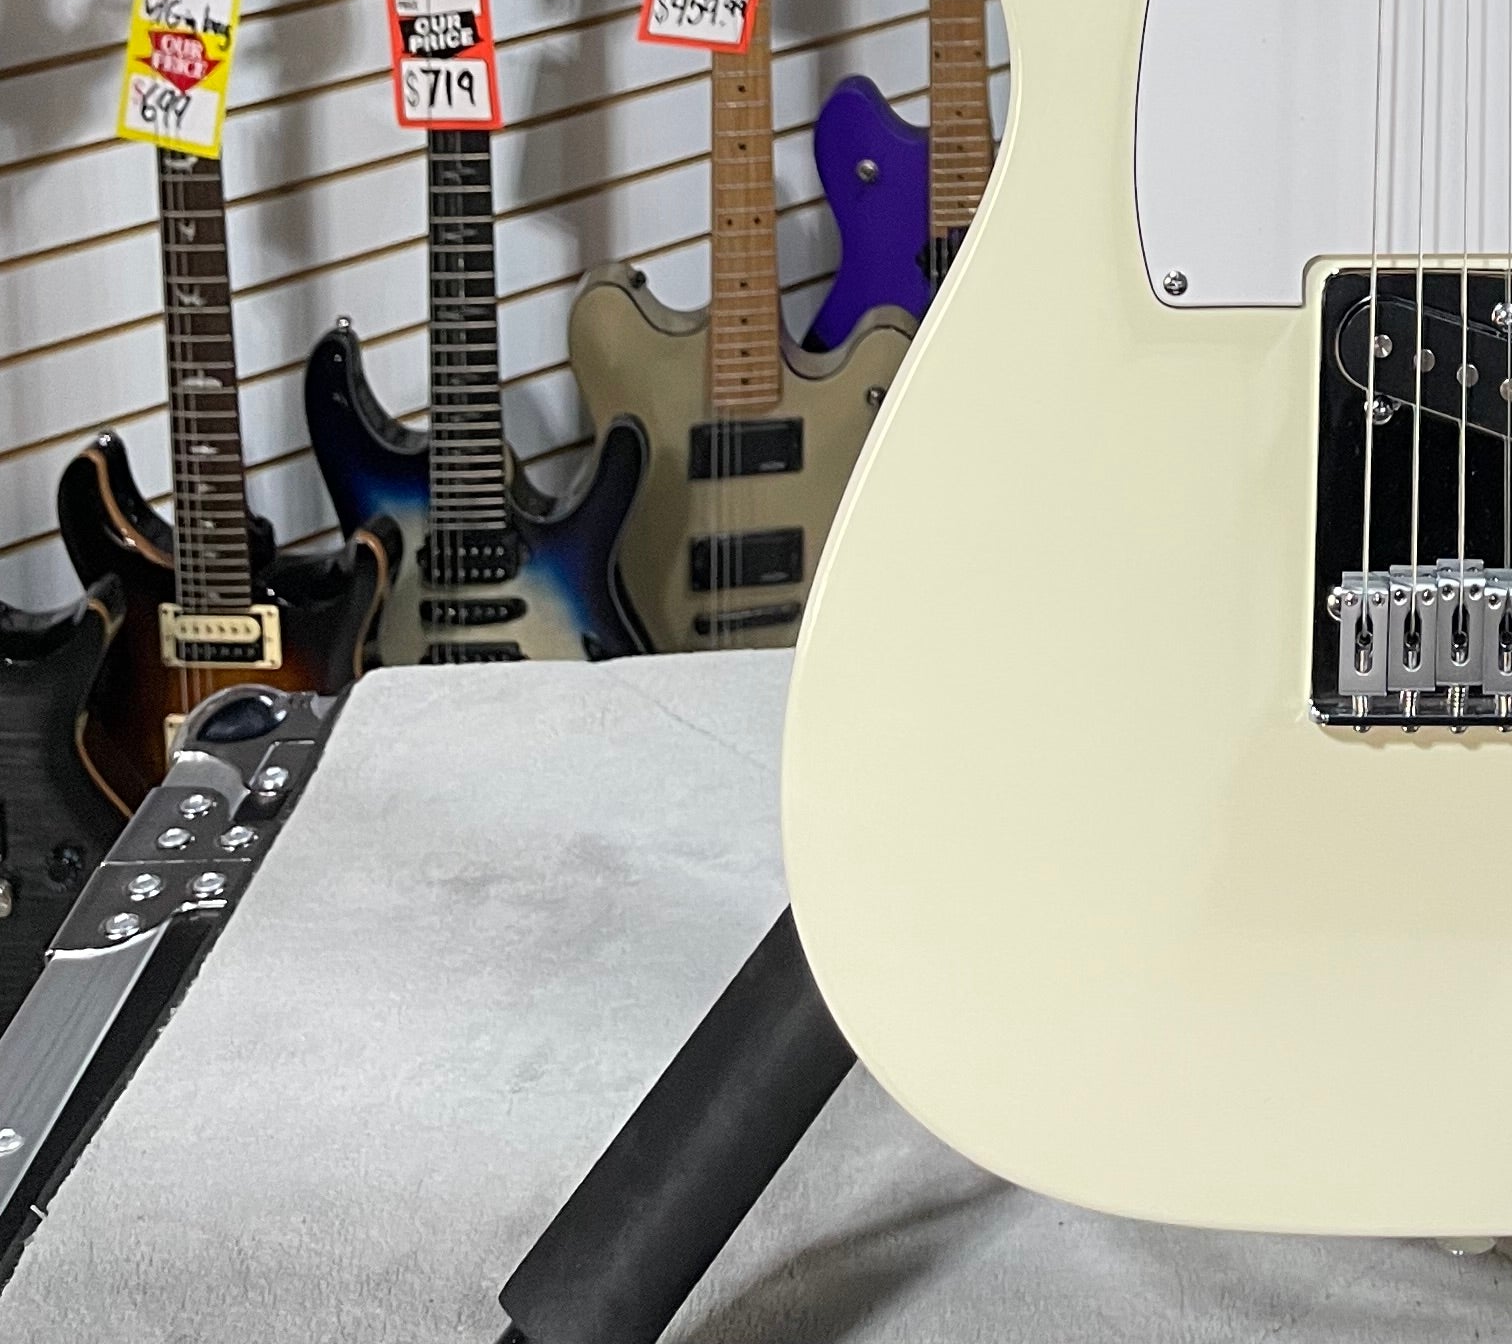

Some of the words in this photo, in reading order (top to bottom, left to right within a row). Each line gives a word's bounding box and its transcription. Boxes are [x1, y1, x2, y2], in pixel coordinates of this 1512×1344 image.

[413, 12, 463, 36] OUR
[160, 33, 205, 60] OUR
[408, 26, 475, 54] PRICE
[150, 49, 209, 80] PRICE
[405, 68, 477, 108] $719
